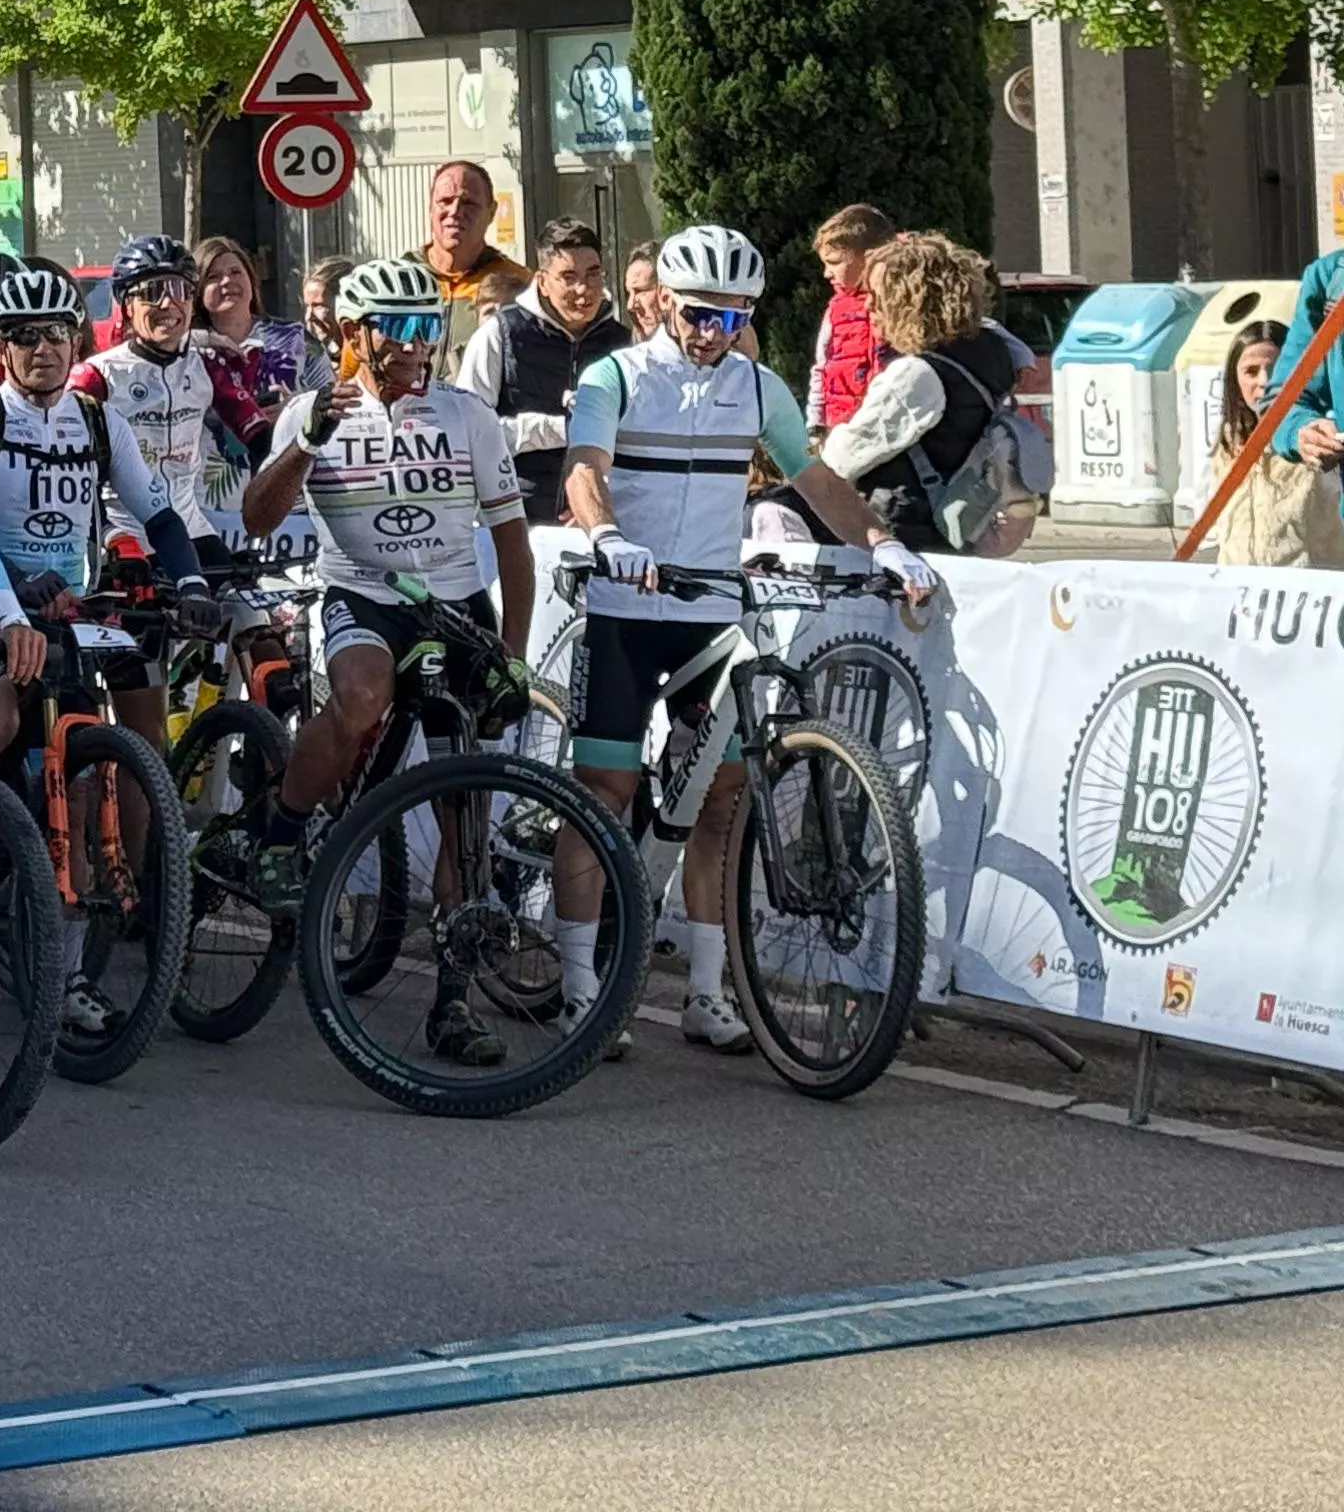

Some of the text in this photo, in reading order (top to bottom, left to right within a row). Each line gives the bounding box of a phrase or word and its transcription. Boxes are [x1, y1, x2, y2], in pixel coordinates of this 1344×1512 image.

[281, 144, 337, 177] 20
[337, 432, 452, 467] TEAM
[379, 467, 455, 496] 108
[1080, 461, 1124, 478] RESTO
[38, 476, 93, 504] 108
[19, 541, 76, 555] TOYOTA
[374, 535, 446, 555] TOYOTA
[96, 627, 113, 641] 2
[1135, 707, 1206, 789] HU
[1133, 784, 1193, 836] 108
[1049, 957, 1110, 983] ARAGÓN
[1286, 1013, 1331, 1037] Huesca
